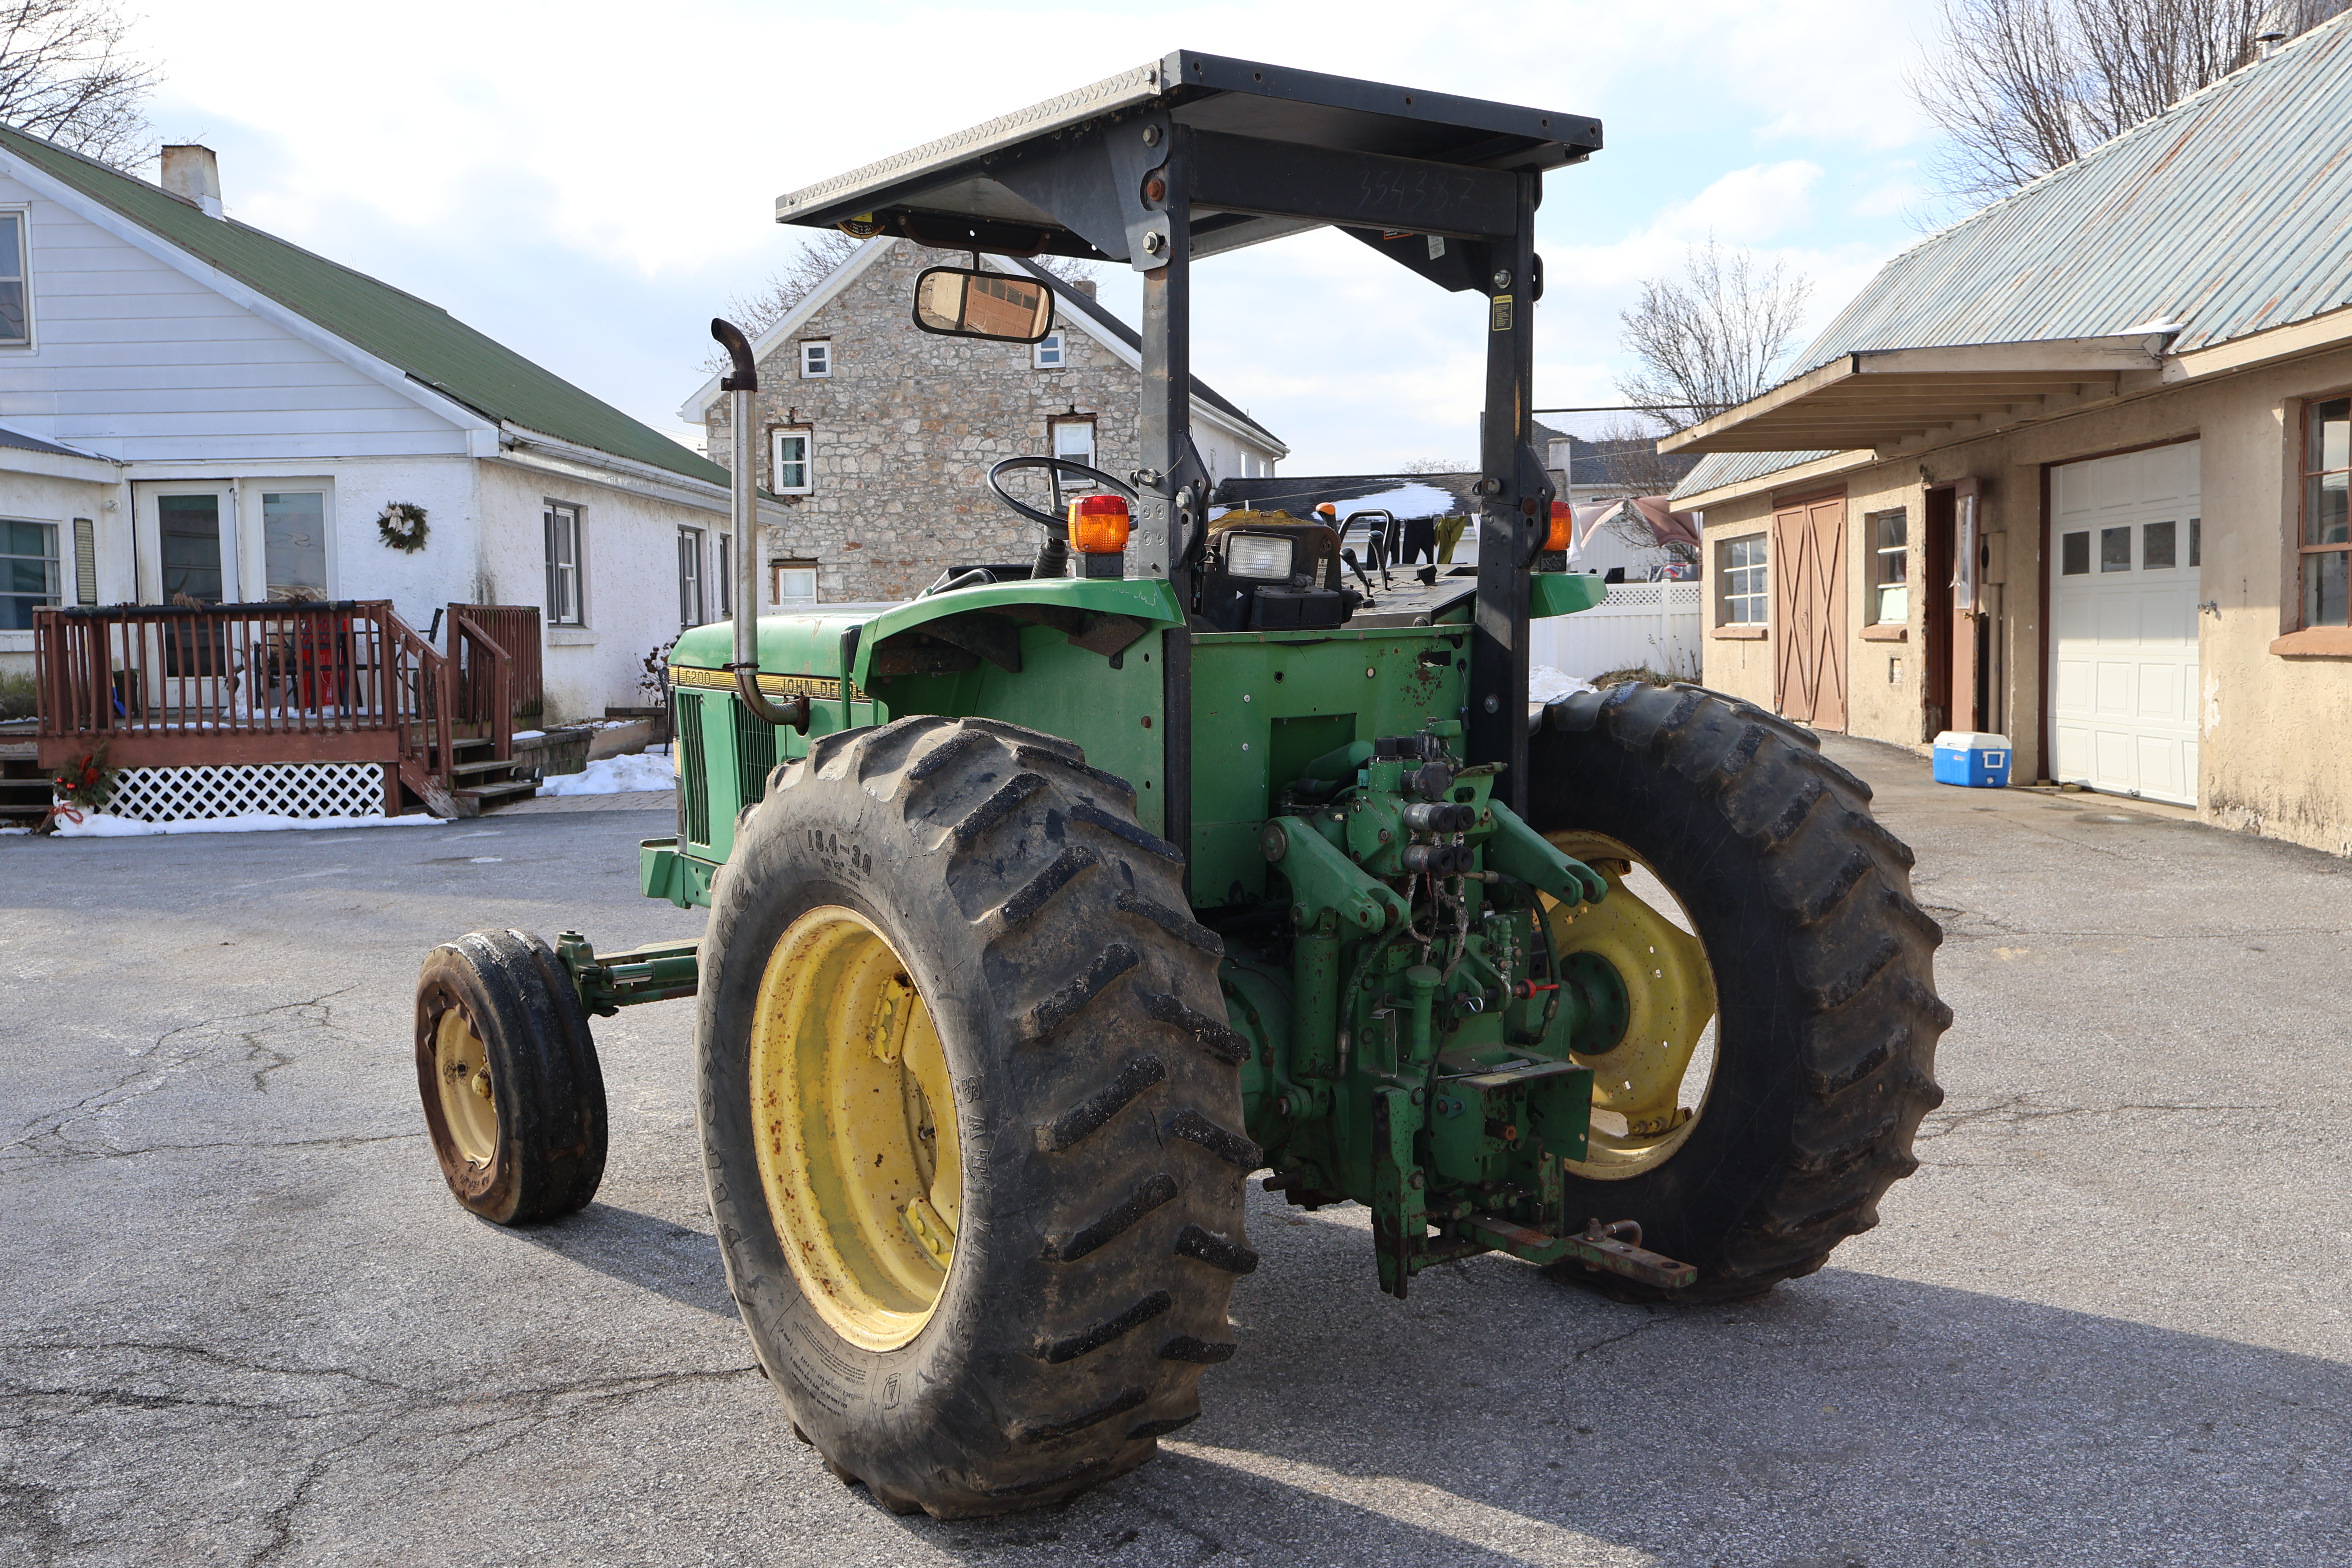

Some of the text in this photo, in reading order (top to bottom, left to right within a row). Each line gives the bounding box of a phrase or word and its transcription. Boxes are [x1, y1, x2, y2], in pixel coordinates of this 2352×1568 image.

[685, 670, 711, 685] 6200
[780, 678, 813, 695] JOHN
[808, 829, 871, 877] 18.4-30
[962, 1076, 990, 1178] SAT
